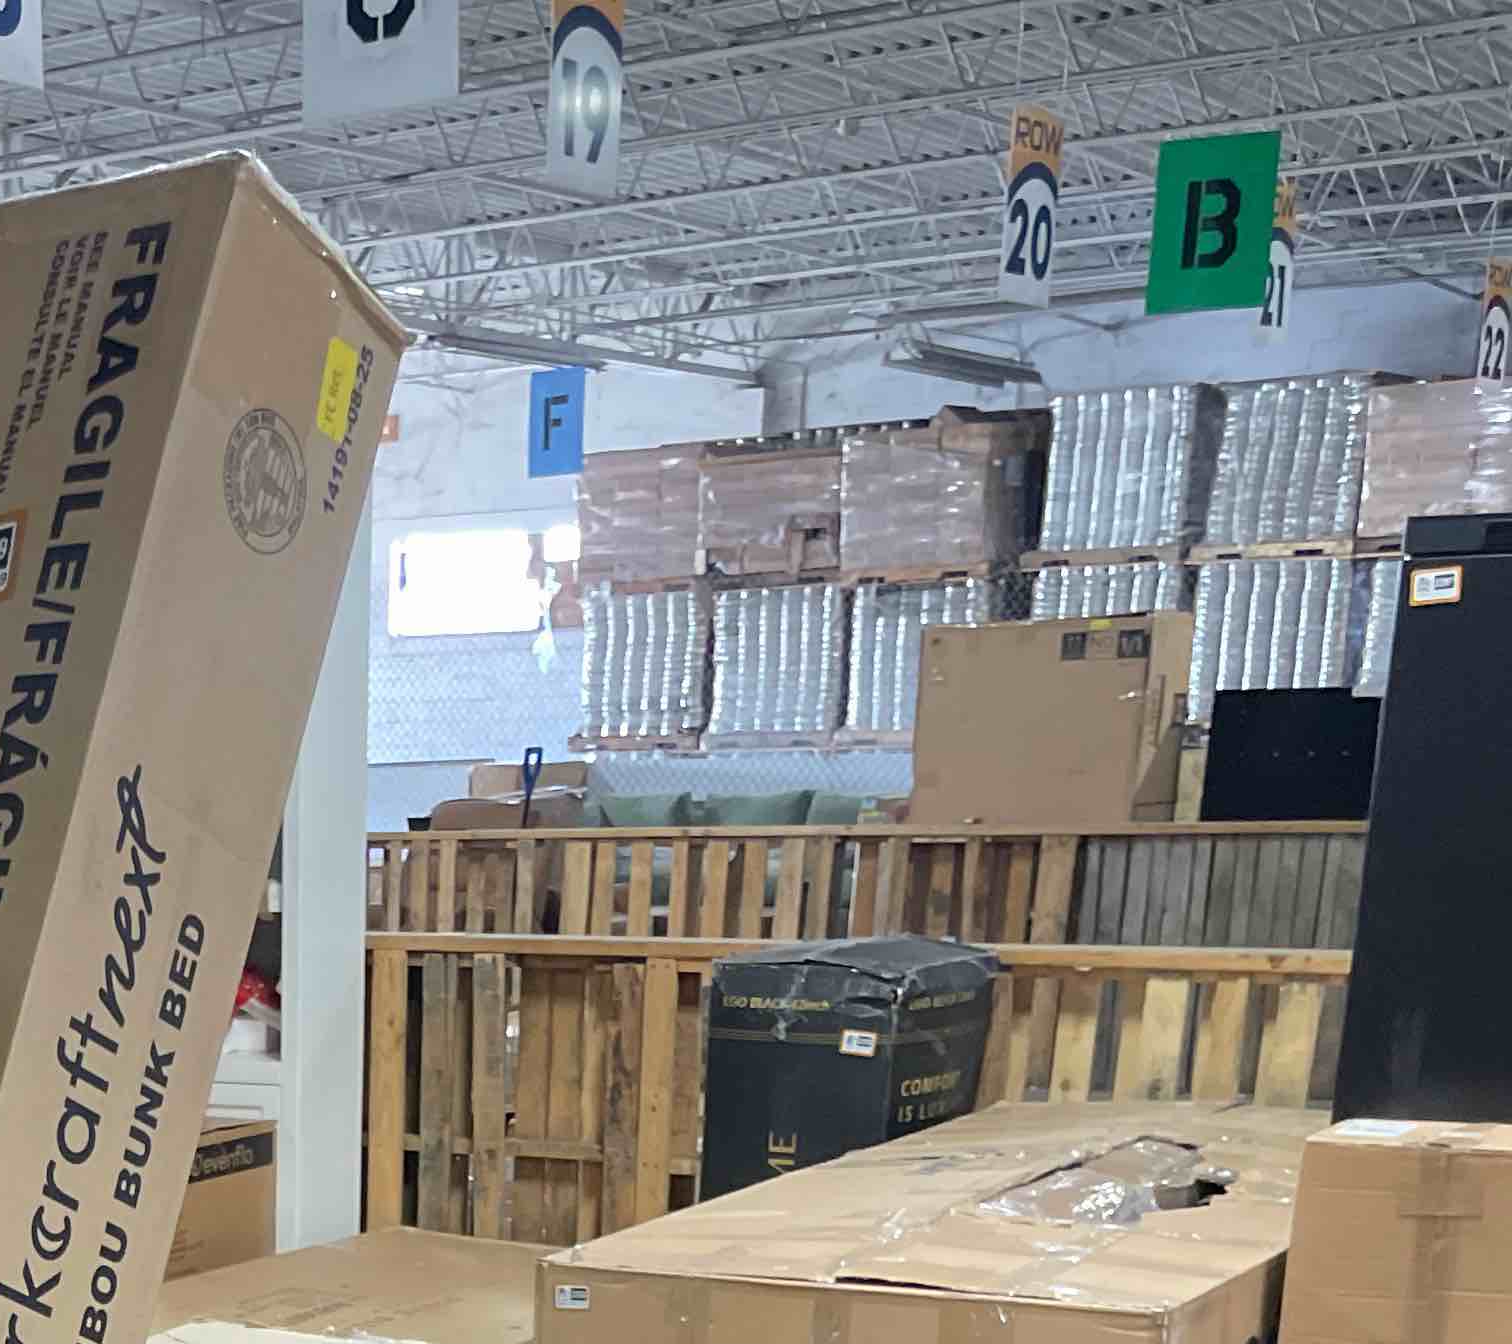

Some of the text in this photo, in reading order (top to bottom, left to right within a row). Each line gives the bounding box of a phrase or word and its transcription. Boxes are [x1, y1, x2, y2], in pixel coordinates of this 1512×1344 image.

[562, 57, 611, 165] 19
[1015, 116, 1064, 156] ROW
[1004, 198, 1053, 281] 20
[1181, 178, 1242, 270] B
[1480, 321, 1506, 381] 22
[542, 394, 570, 452] F
[115, 1039, 176, 1209] BUNK
[159, 912, 207, 1024] BED
